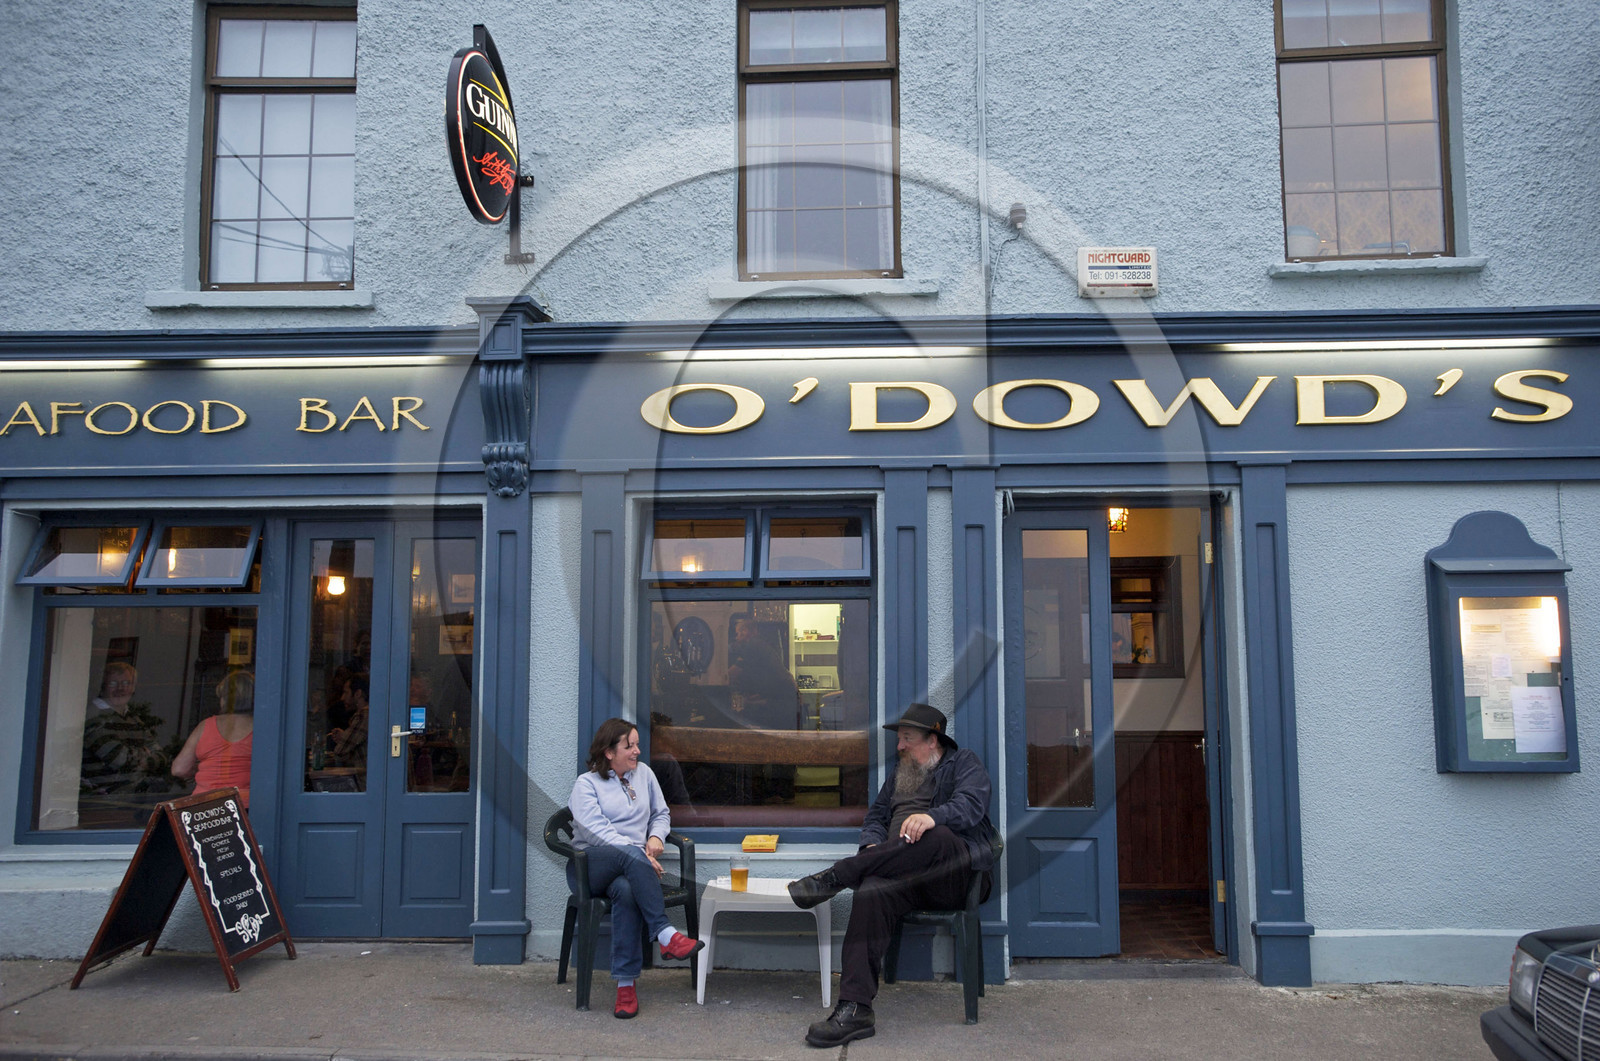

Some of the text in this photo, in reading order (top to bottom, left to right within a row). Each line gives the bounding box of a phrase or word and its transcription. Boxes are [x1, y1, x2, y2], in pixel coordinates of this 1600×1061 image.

[1088, 253, 1151, 263] NIGHTGUARD
[1089, 271, 1151, 280] Tel: 091-528238
[640, 368, 1574, 435] O'DOWD'S
[296, 396, 430, 433] BAR
[194, 816, 232, 832] SEAFOOD BAR
[220, 865, 242, 878] SPECIALS
[223, 889, 254, 905] FOOD SERVED
